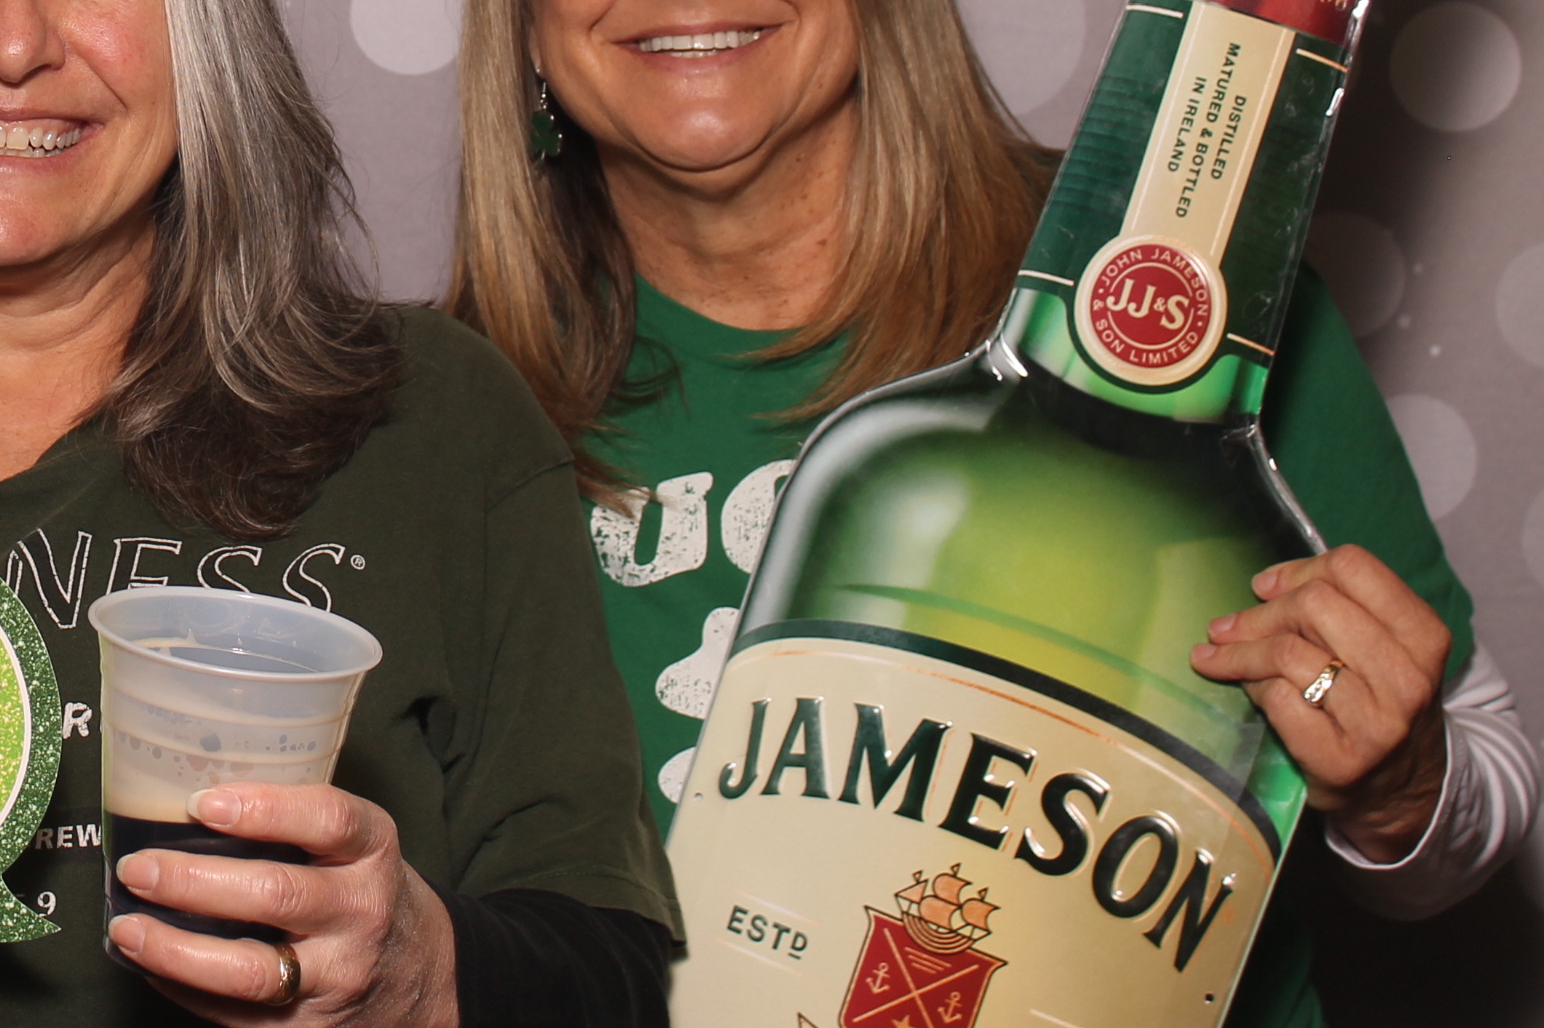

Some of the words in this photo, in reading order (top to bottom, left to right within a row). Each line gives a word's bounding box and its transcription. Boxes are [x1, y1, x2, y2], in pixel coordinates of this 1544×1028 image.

[1192, 76, 1207, 94] IN
[1206, 42, 1241, 123] MATURED
[1167, 98, 1200, 172] IRELAND
[1200, 128, 1213, 138] &
[1211, 95, 1247, 180] DISTILLED
[1176, 143, 1209, 218] BOTTLED
[1101, 249, 1143, 286] JOHN
[1151, 248, 1209, 315] JAMESON
[1093, 299, 1104, 311] &
[1106, 278, 1190, 330] JJ&S
[1095, 318, 1125, 353] SON
[1129, 331, 1199, 364] LIMITED
[718, 697, 1237, 973] JAMESON
[727, 905, 808, 960] ESTD
